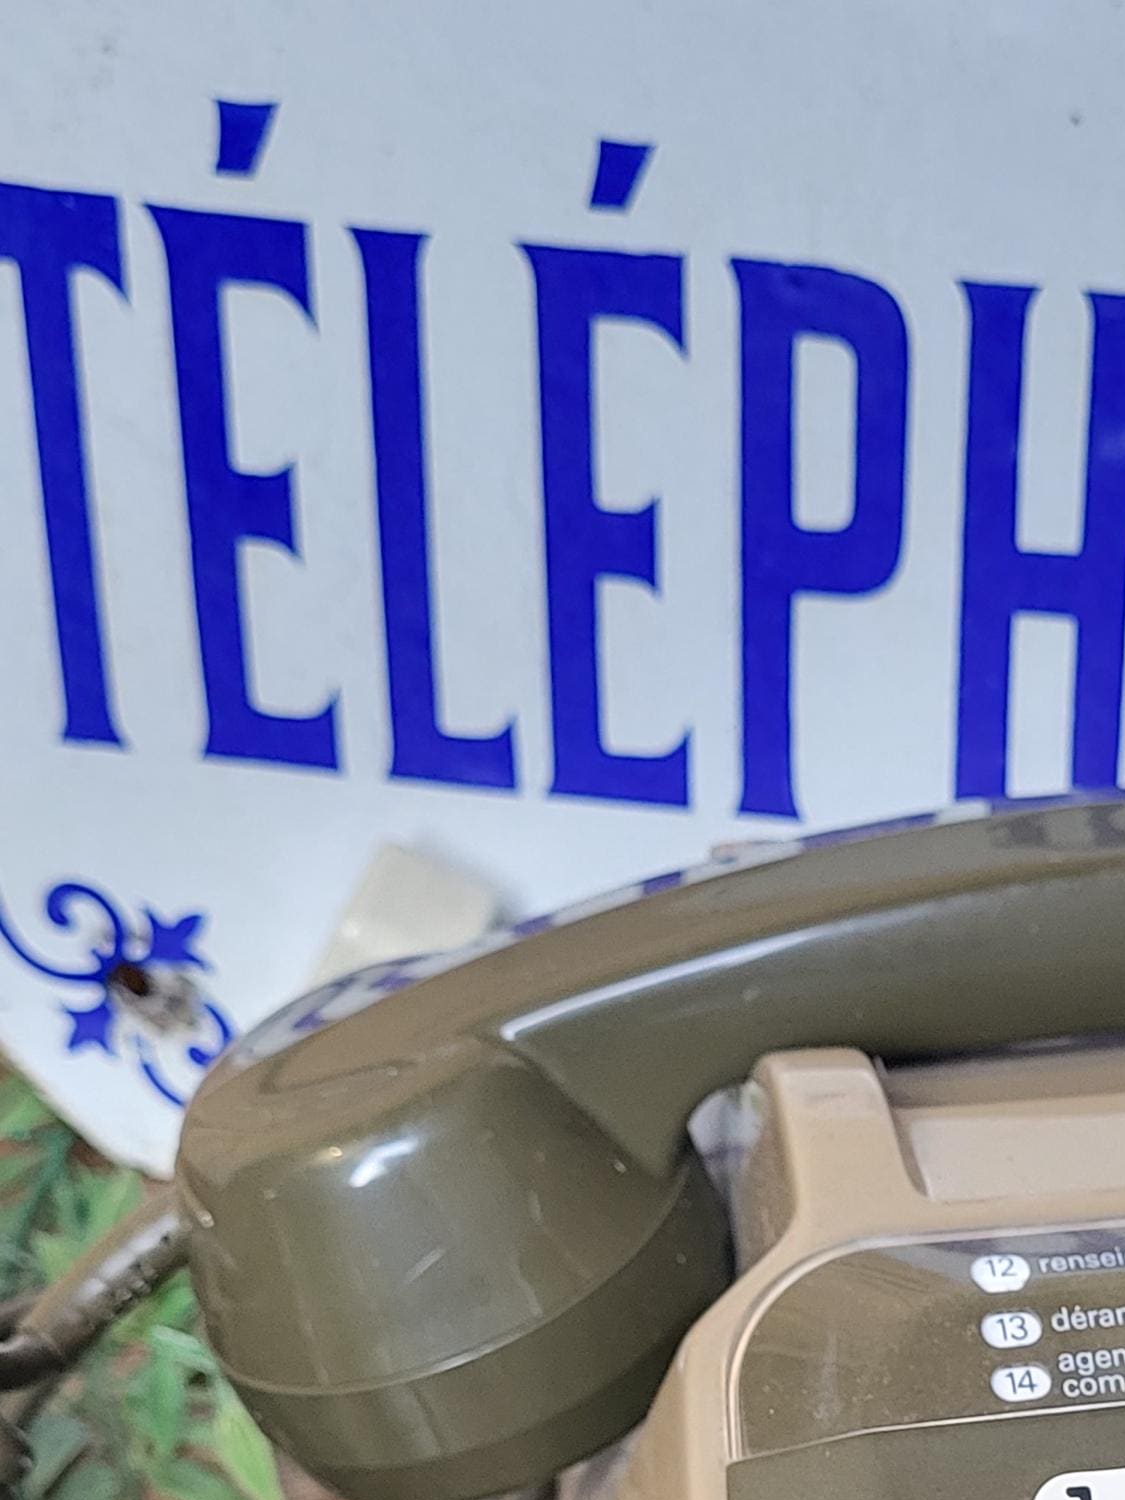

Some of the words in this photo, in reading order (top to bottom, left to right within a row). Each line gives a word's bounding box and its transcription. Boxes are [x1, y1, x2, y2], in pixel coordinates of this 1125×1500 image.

[984, 1256, 1018, 1279] 12
[995, 1314, 1030, 1342] 13
[1003, 1369, 1039, 1396] 14
